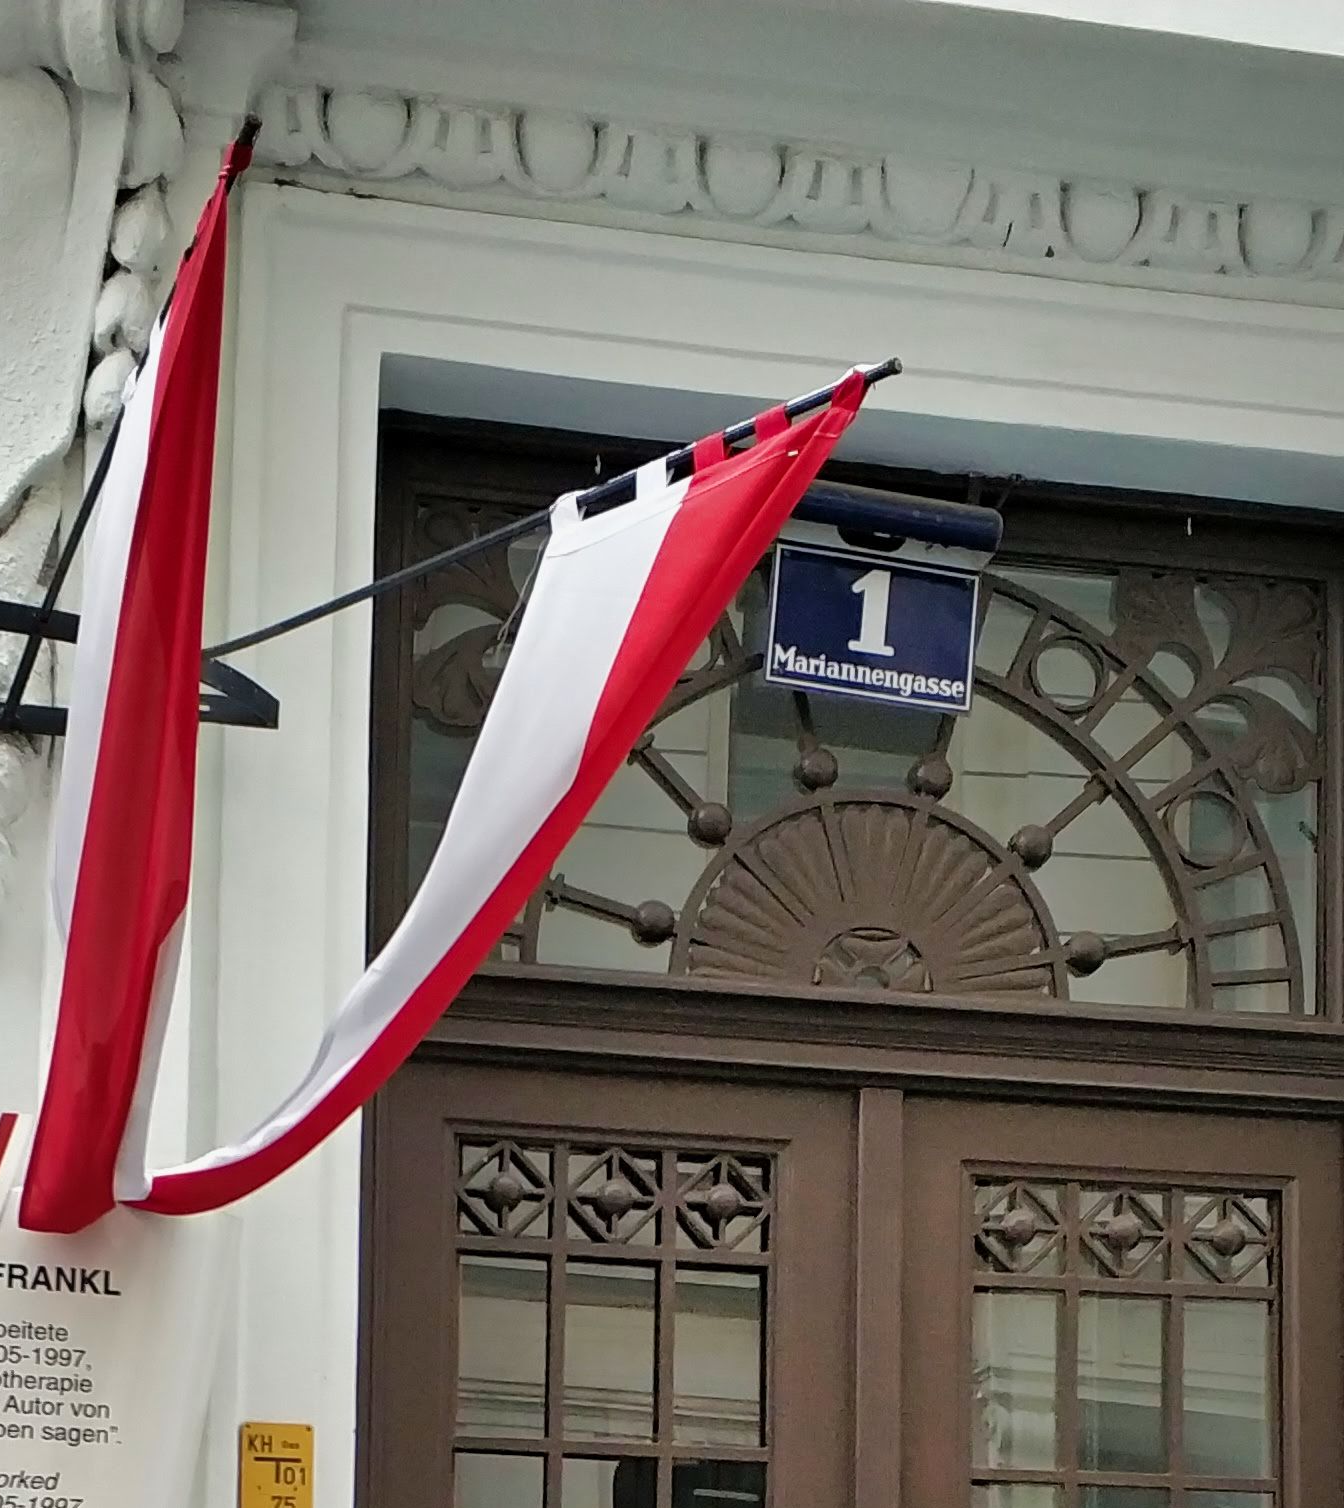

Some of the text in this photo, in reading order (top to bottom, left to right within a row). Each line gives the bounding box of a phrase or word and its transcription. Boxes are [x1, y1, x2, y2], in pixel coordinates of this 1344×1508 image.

[848, 569, 895, 656] 1
[772, 643, 965, 698] Mariannengasse
[3, 1395, 64, 1416] Autor
[70, 1403, 110, 1419] von
[247, 1434, 272, 1453] KH
